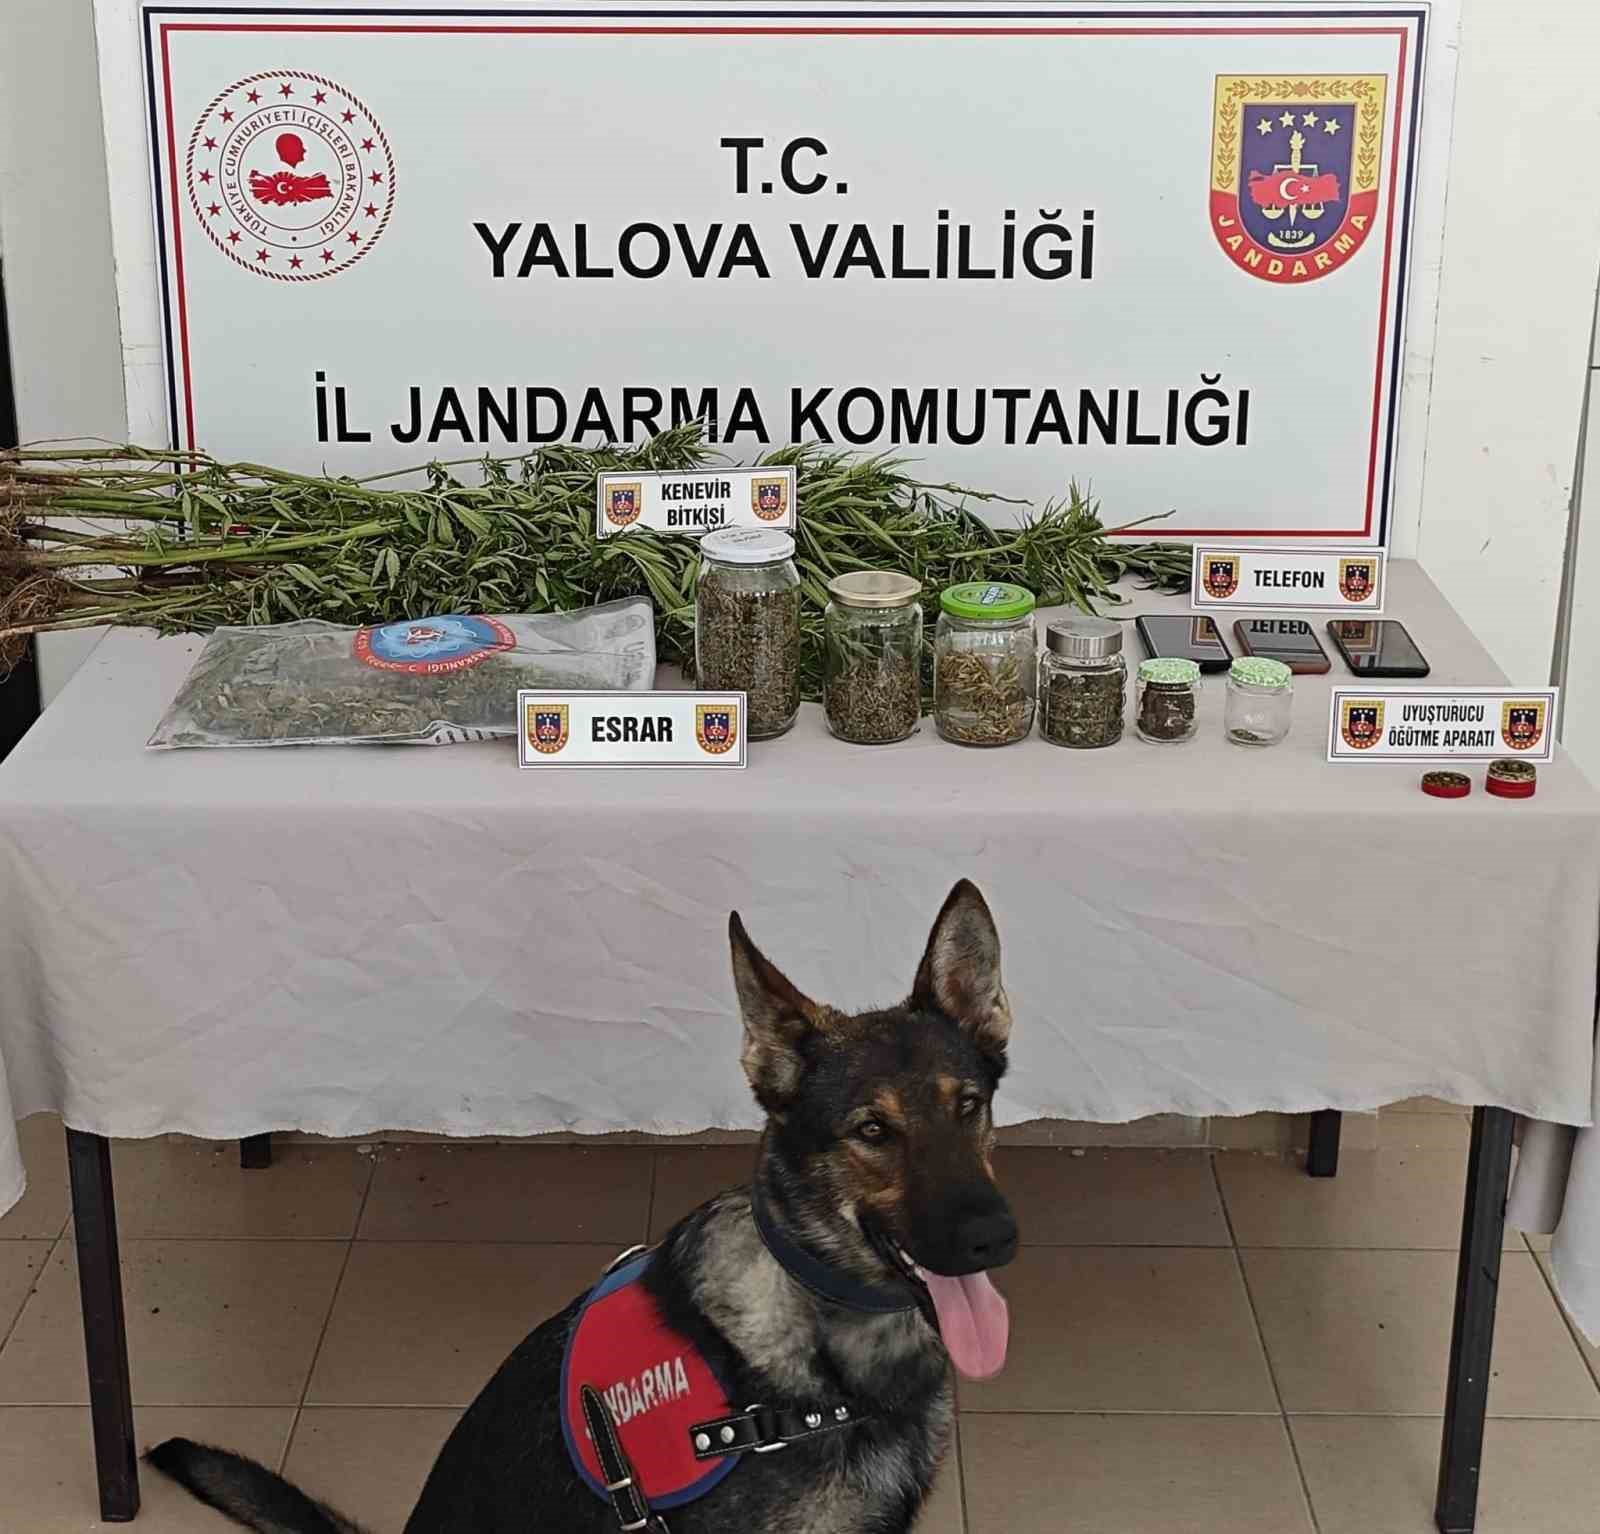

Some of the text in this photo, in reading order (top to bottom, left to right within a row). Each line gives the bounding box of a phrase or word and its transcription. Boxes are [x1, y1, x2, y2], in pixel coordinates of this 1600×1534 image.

[226, 109, 356, 236] TÜRKİYE CUMHURİYETİ İÇİŞLERİ BAKANLIĞI
[721, 137, 848, 195] T.C.
[474, 208, 1095, 280] YALOVA VALİLİĞİ
[1218, 214, 1369, 276] JANDARMA
[1279, 229, 1304, 240] 1839
[315, 371, 1251, 446] İL JANDARMA KOMUTANLIĞI
[661, 478, 731, 501] KENEVİR
[667, 503, 725, 526] BİTKİSİ
[1254, 569, 1325, 588] TELEFON
[1402, 705, 1485, 726] UYUŞTURUCU
[591, 716, 673, 743] ESRAR
[1388, 725, 1439, 747] ÖĞÜTME
[1442, 729, 1495, 747] APARATI
